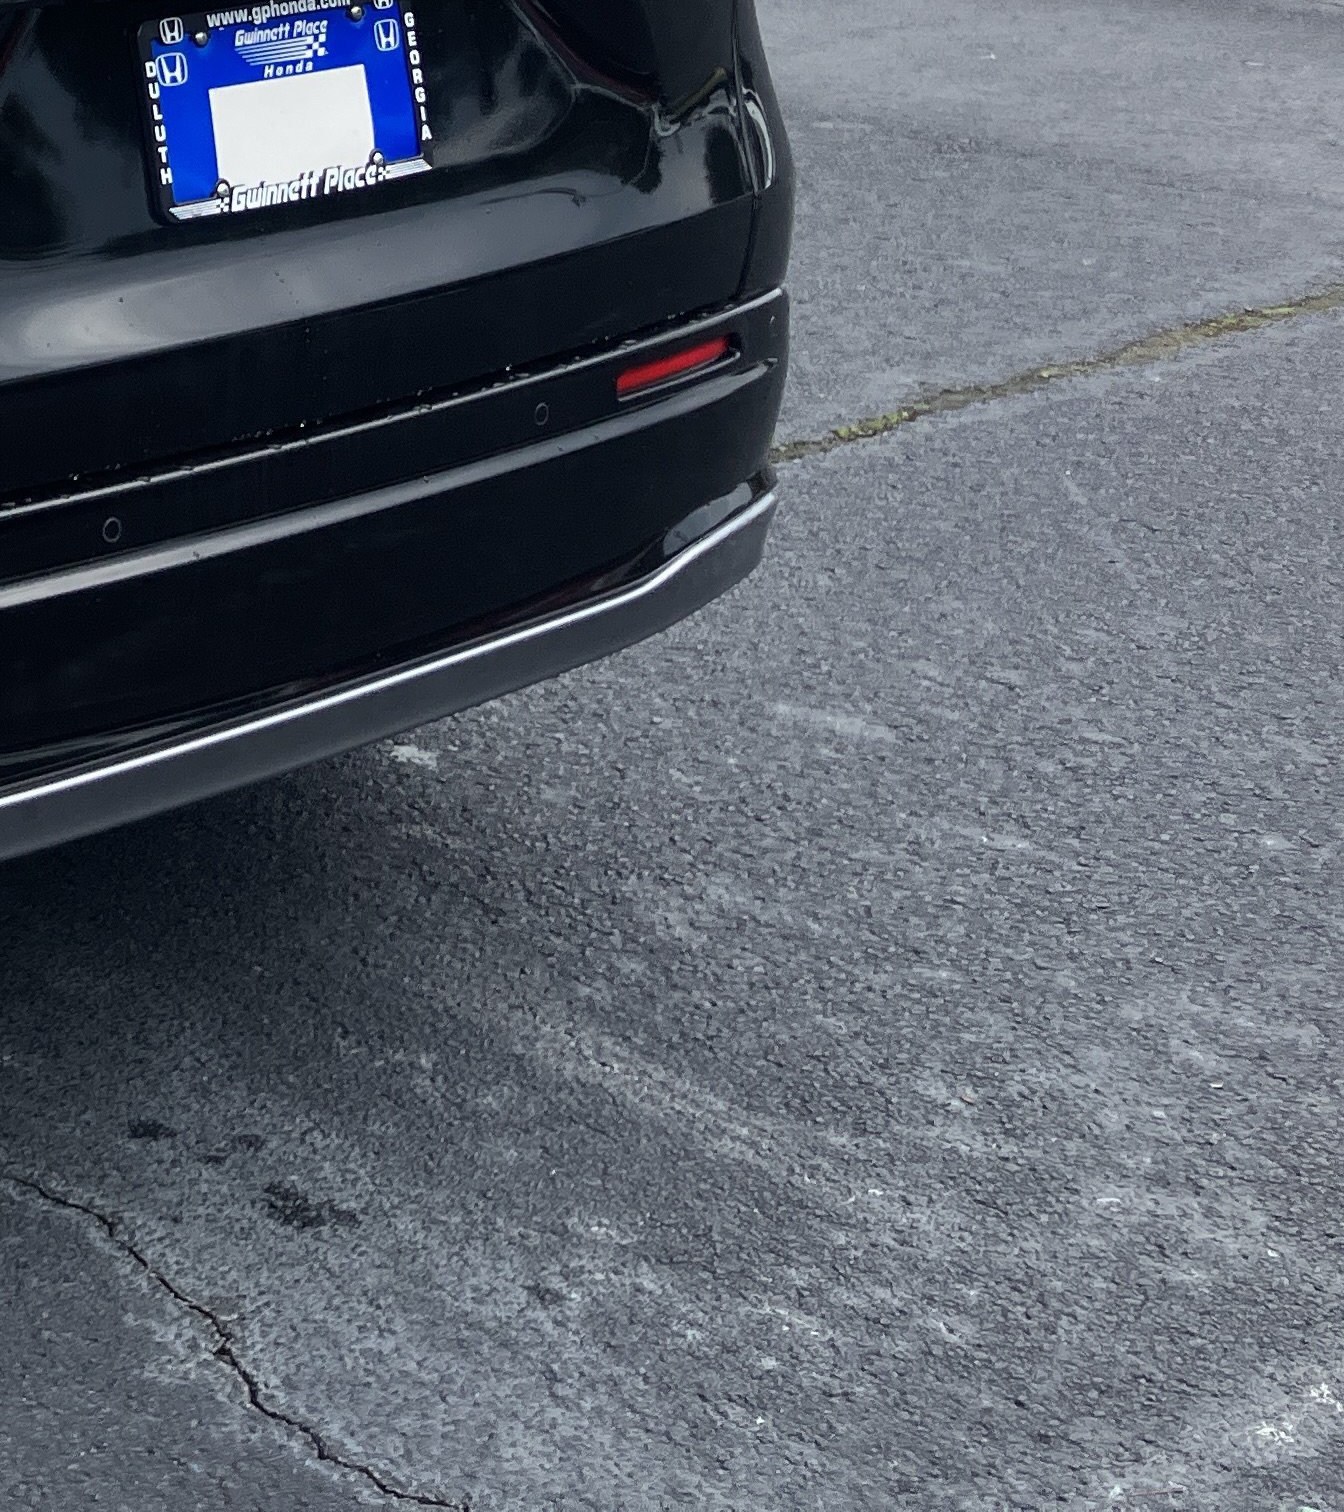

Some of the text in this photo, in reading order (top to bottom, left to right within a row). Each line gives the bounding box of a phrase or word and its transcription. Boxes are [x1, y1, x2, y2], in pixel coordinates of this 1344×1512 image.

[234, 19, 329, 47] Gwinnett Place
[263, 59, 314, 79] Honda
[403, 11, 433, 141] GEORGIA
[144, 60, 173, 185] DULUTH
[231, 164, 377, 213] Gwinnett Place
